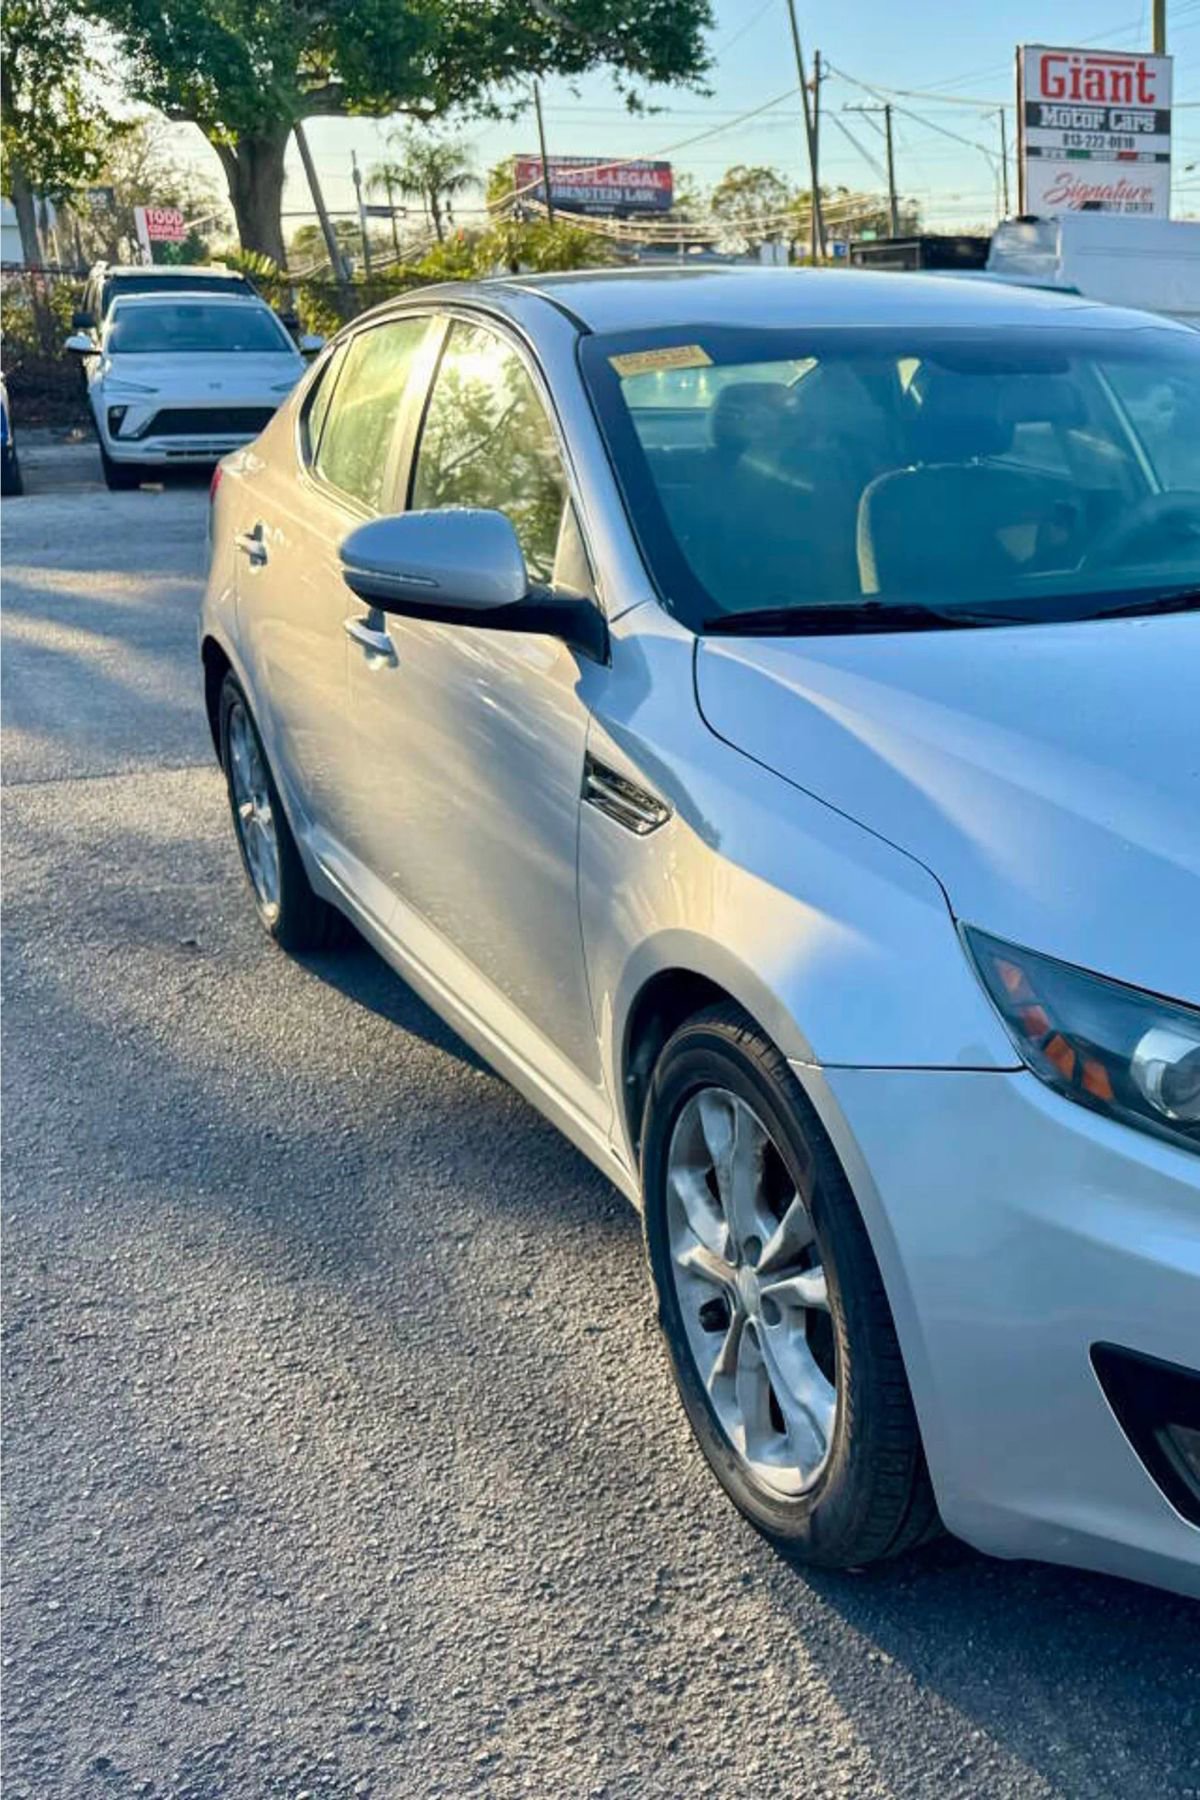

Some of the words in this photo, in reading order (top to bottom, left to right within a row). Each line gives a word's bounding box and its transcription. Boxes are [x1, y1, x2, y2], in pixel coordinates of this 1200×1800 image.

[1040, 54, 1156, 104] Giant
[1039, 105, 1105, 130] Motor
[1109, 109, 1156, 132] Cars
[147, 208, 184, 226] TODD
